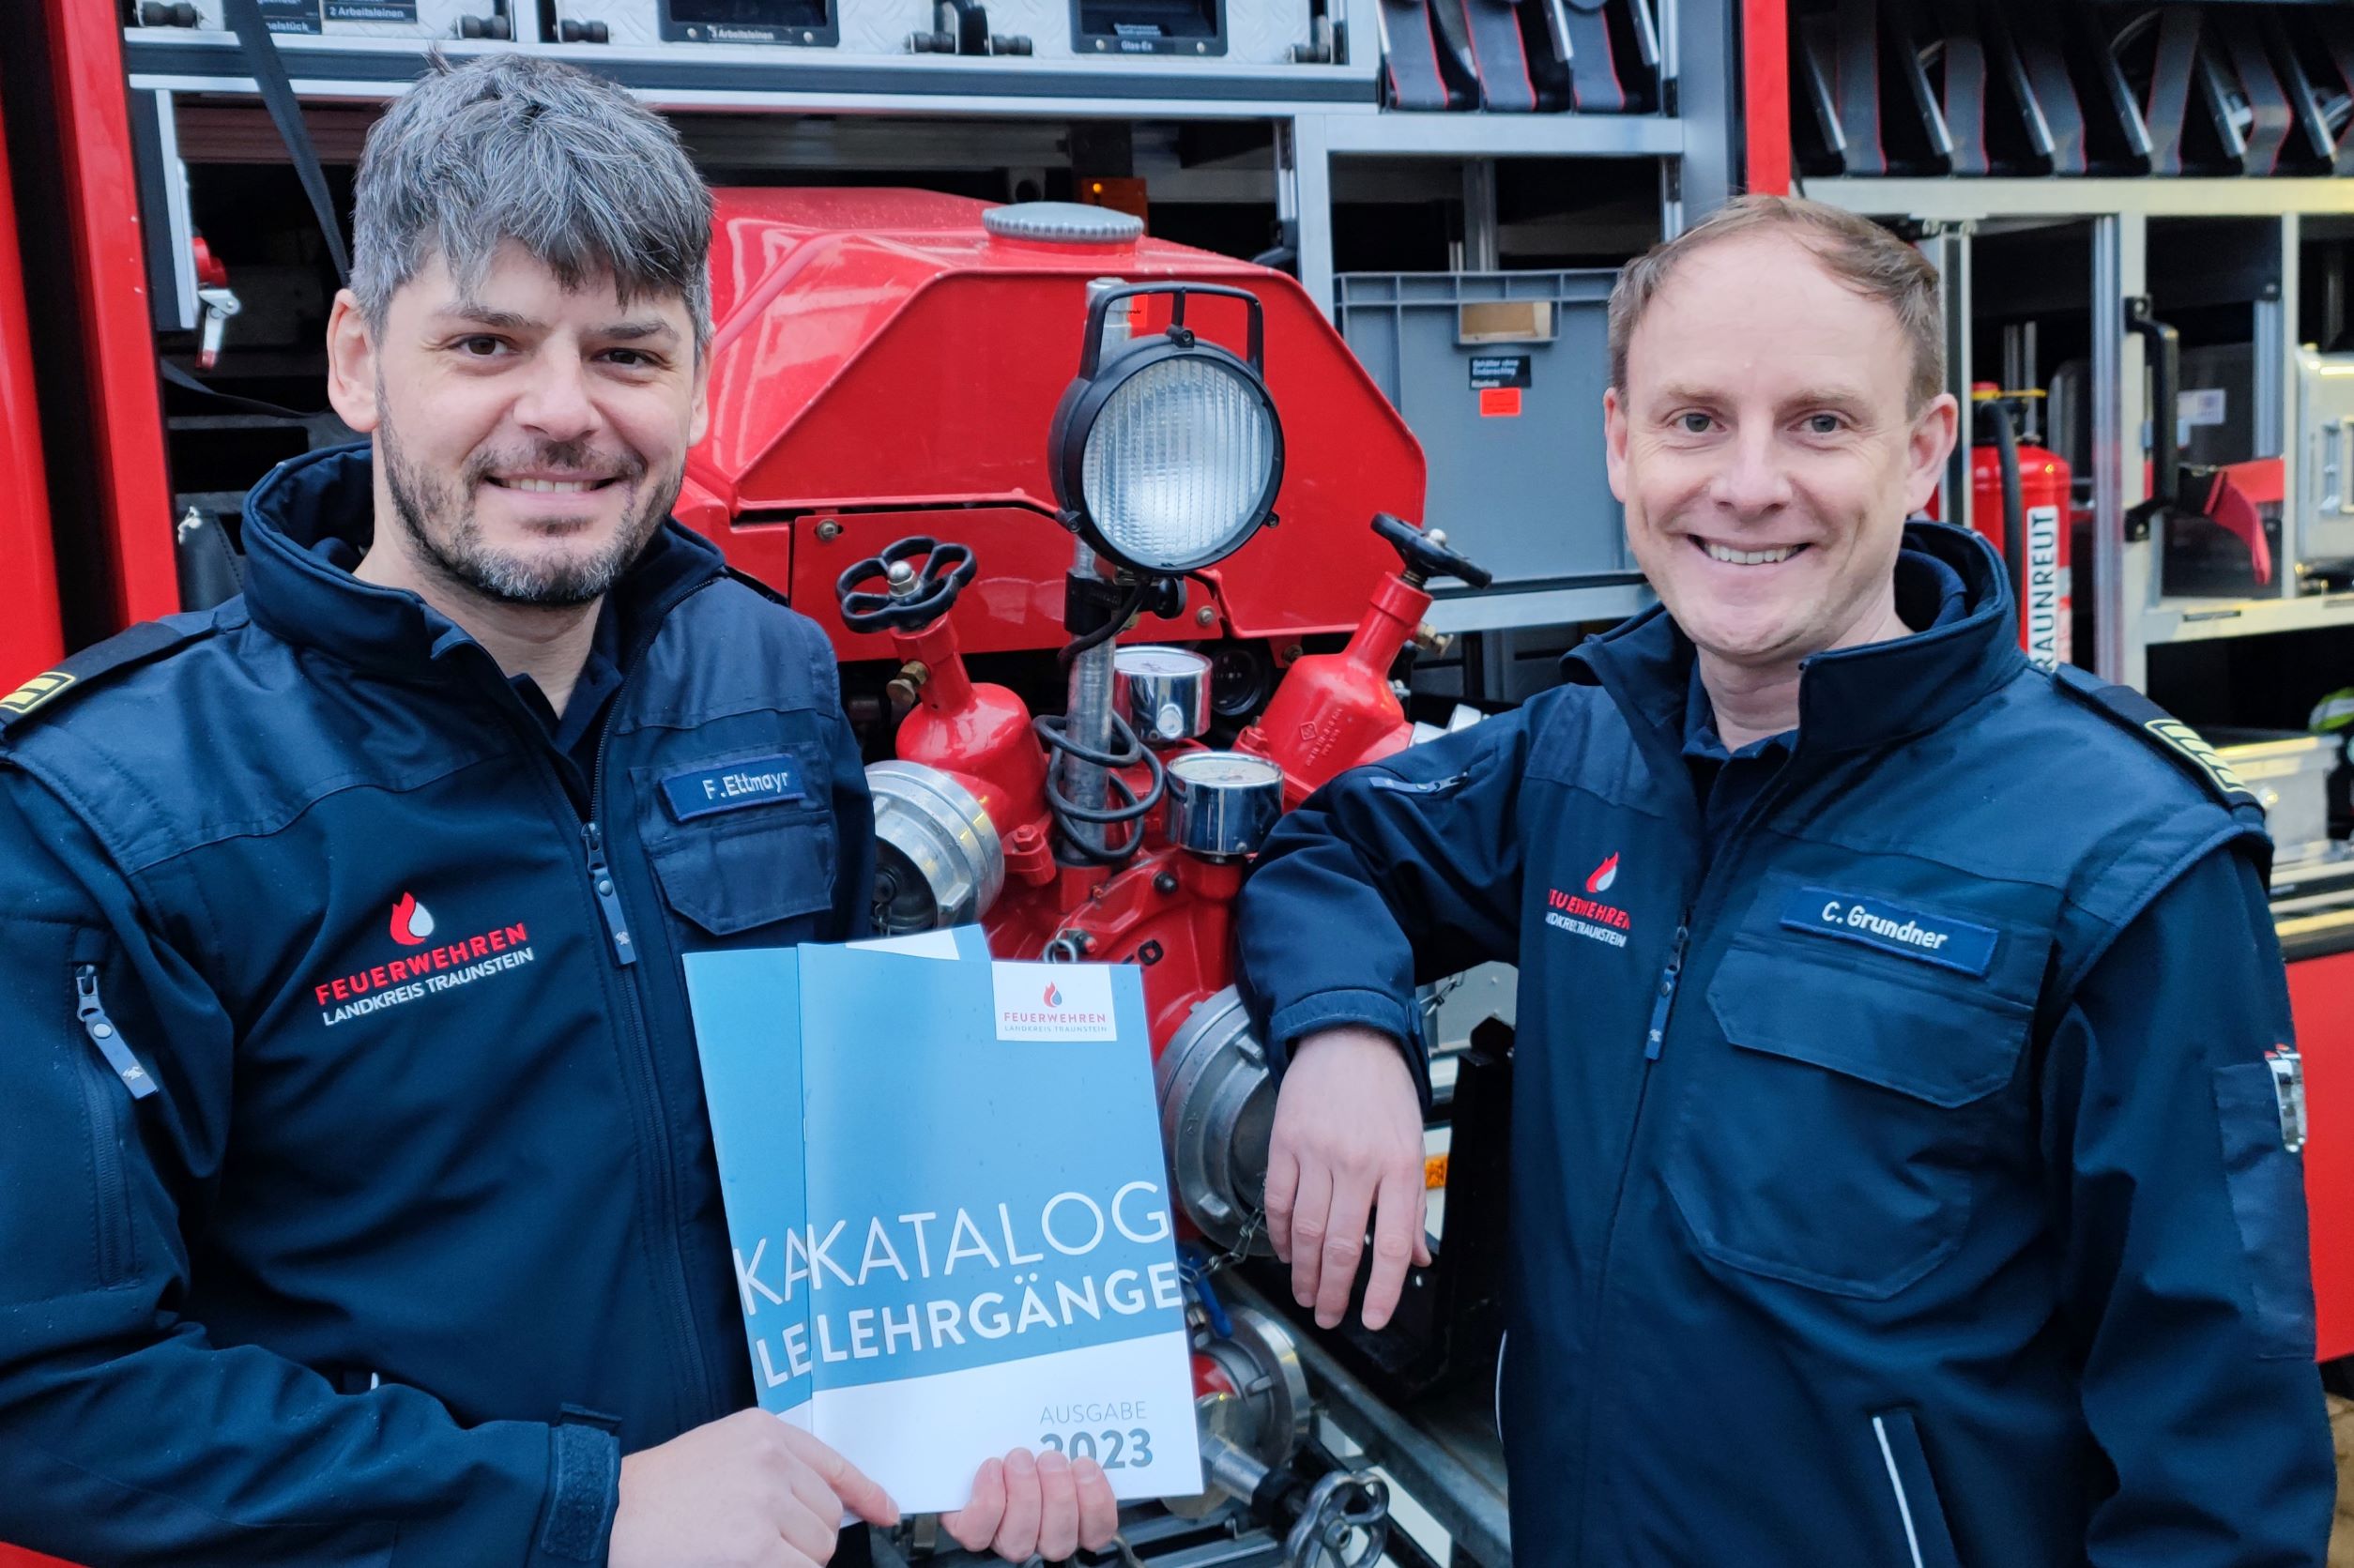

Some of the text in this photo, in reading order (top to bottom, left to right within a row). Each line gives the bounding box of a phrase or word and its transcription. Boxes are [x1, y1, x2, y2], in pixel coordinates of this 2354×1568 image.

[338, 7, 405, 18] Arbeitsleinen
[313, 922, 527, 1006] FEUERWEHREN
[322, 946, 534, 1027] LANDKREIS TRAUNSTEIN
[1003, 1012, 1107, 1024] FEUERWEHREN
[806, 1180, 1170, 1290] KATALOG
[817, 1261, 1184, 1363] LEHRGÄNGE
[1039, 1400, 1148, 1425] AUSGABE
